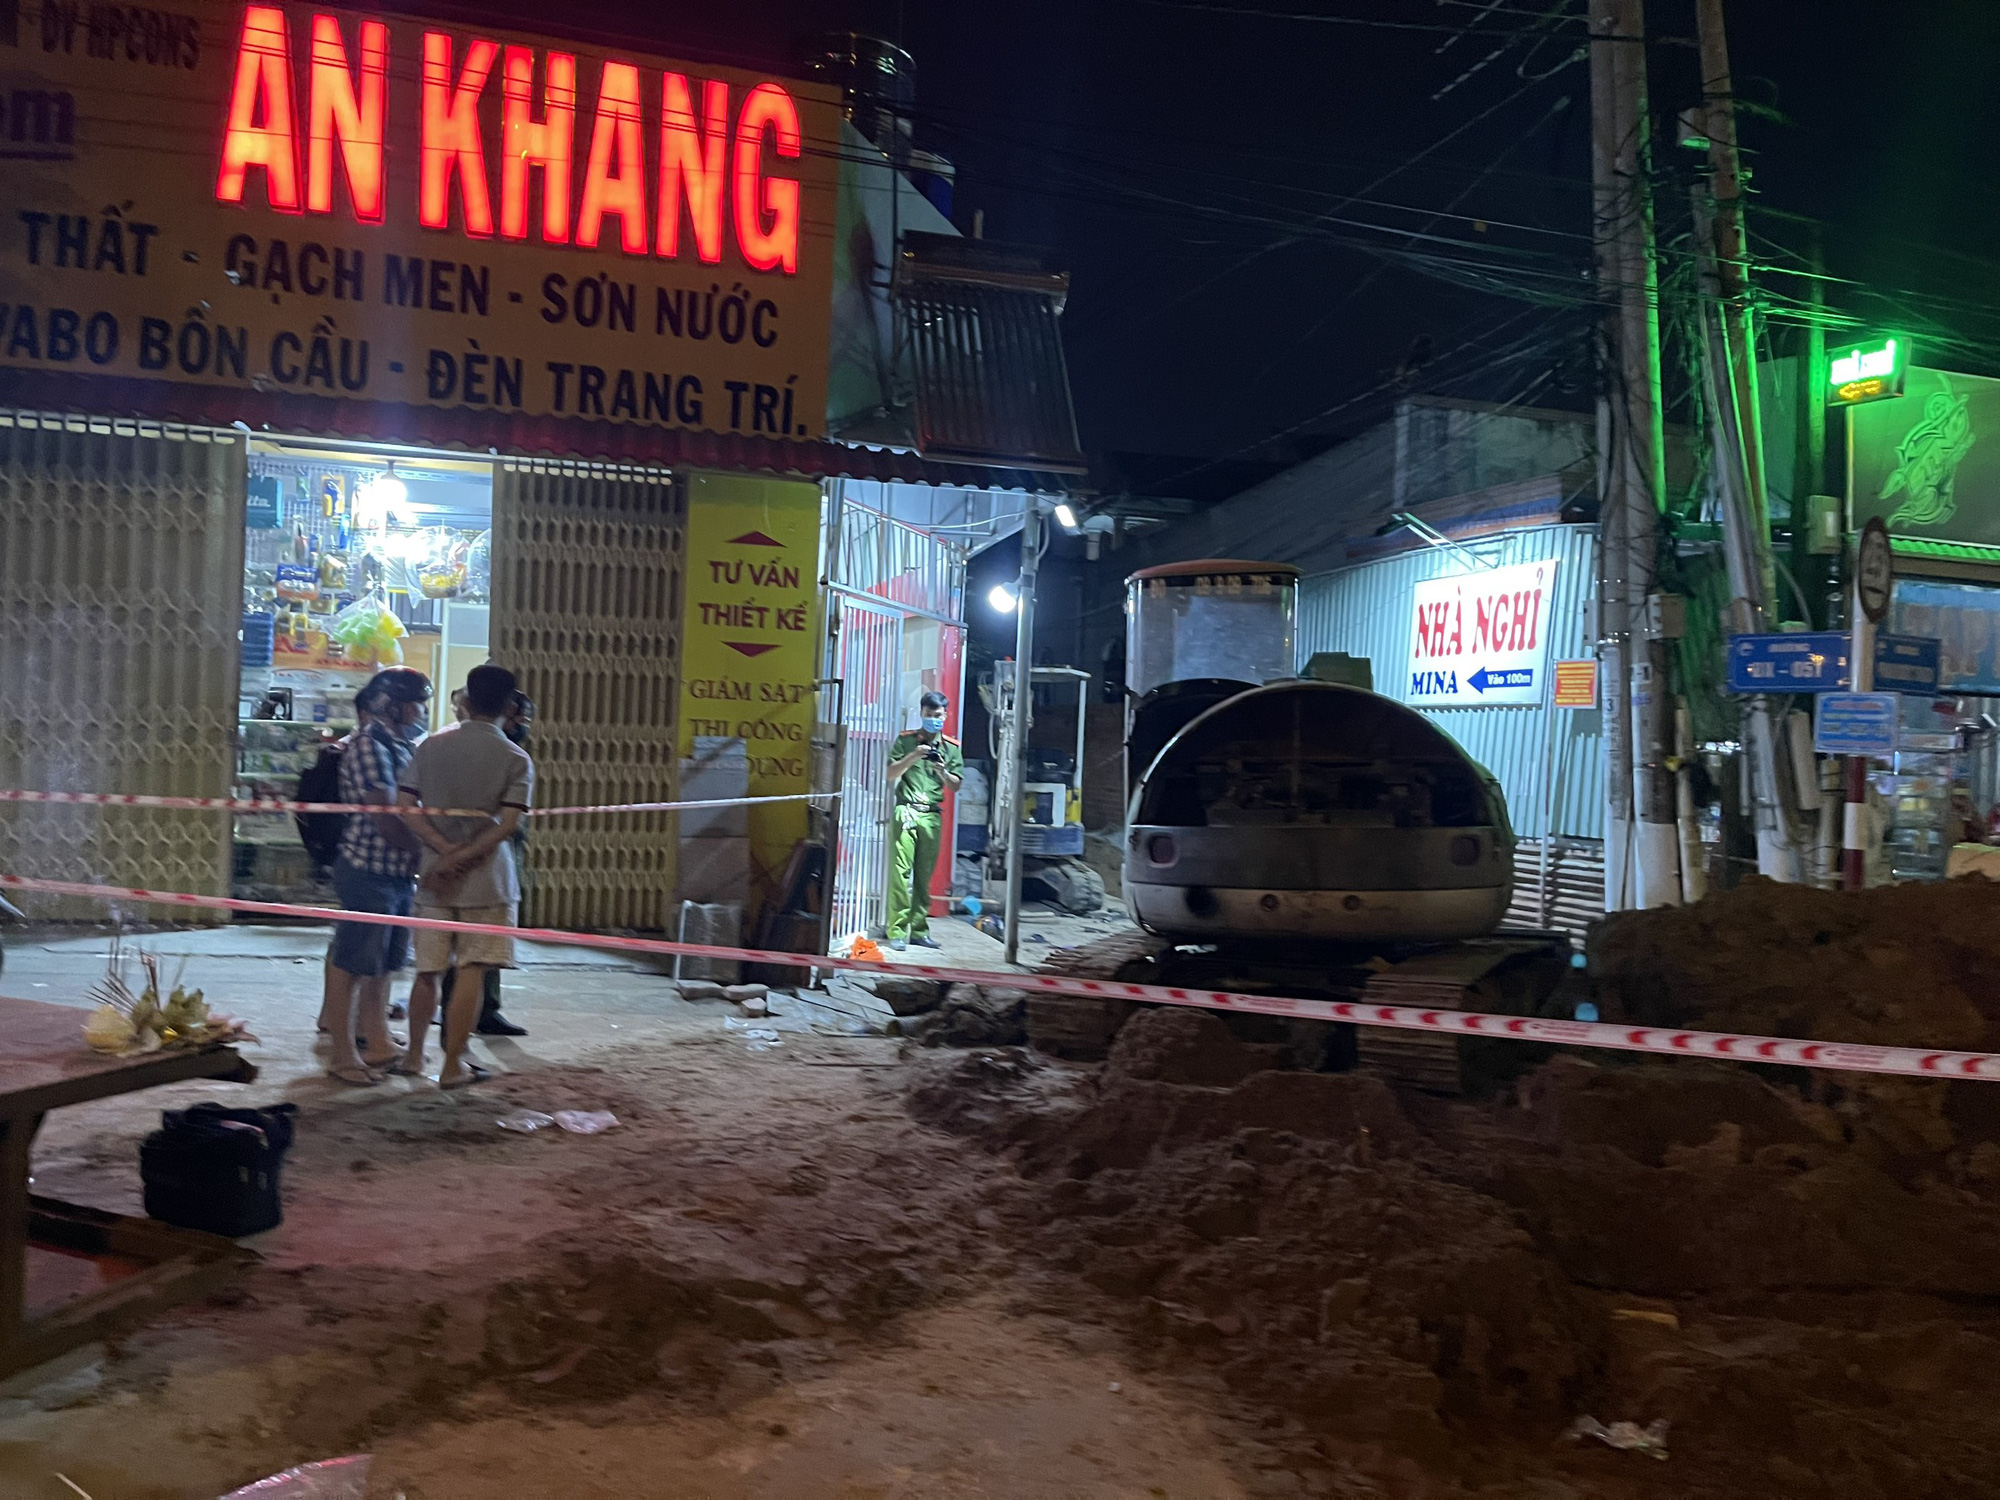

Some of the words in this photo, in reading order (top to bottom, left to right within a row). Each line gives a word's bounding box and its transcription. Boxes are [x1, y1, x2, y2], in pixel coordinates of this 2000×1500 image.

[215, 5, 387, 223] AN
[419, 32, 800, 274] KHANG
[19, 200, 159, 276] THẤT
[224, 232, 364, 304] GẠCH
[384, 253, 490, 316] MEN
[541, 271, 636, 332] SƠN
[656, 282, 778, 348] NƯỚC
[139, 306, 249, 380] BỒN
[270, 315, 370, 393] CẦU
[427, 338, 523, 408] ĐÈN
[547, 361, 703, 424] TRANG
[725, 375, 807, 437] TRÍ.
[709, 559, 743, 584] TƯ
[748, 556, 799, 589] VẤN
[698, 597, 770, 629] THIẾT
[776, 600, 808, 631] KẾ
[1415, 585, 1462, 659] NHÀ
[1472, 567, 1543, 654] NGHỈ
[1411, 670, 1458, 695] MINA
[1487, 674, 1505, 685] Vào
[1506, 673, 1531, 684] 100m
[689, 718, 730, 736] THI
[737, 718, 802, 741] CÔNG
